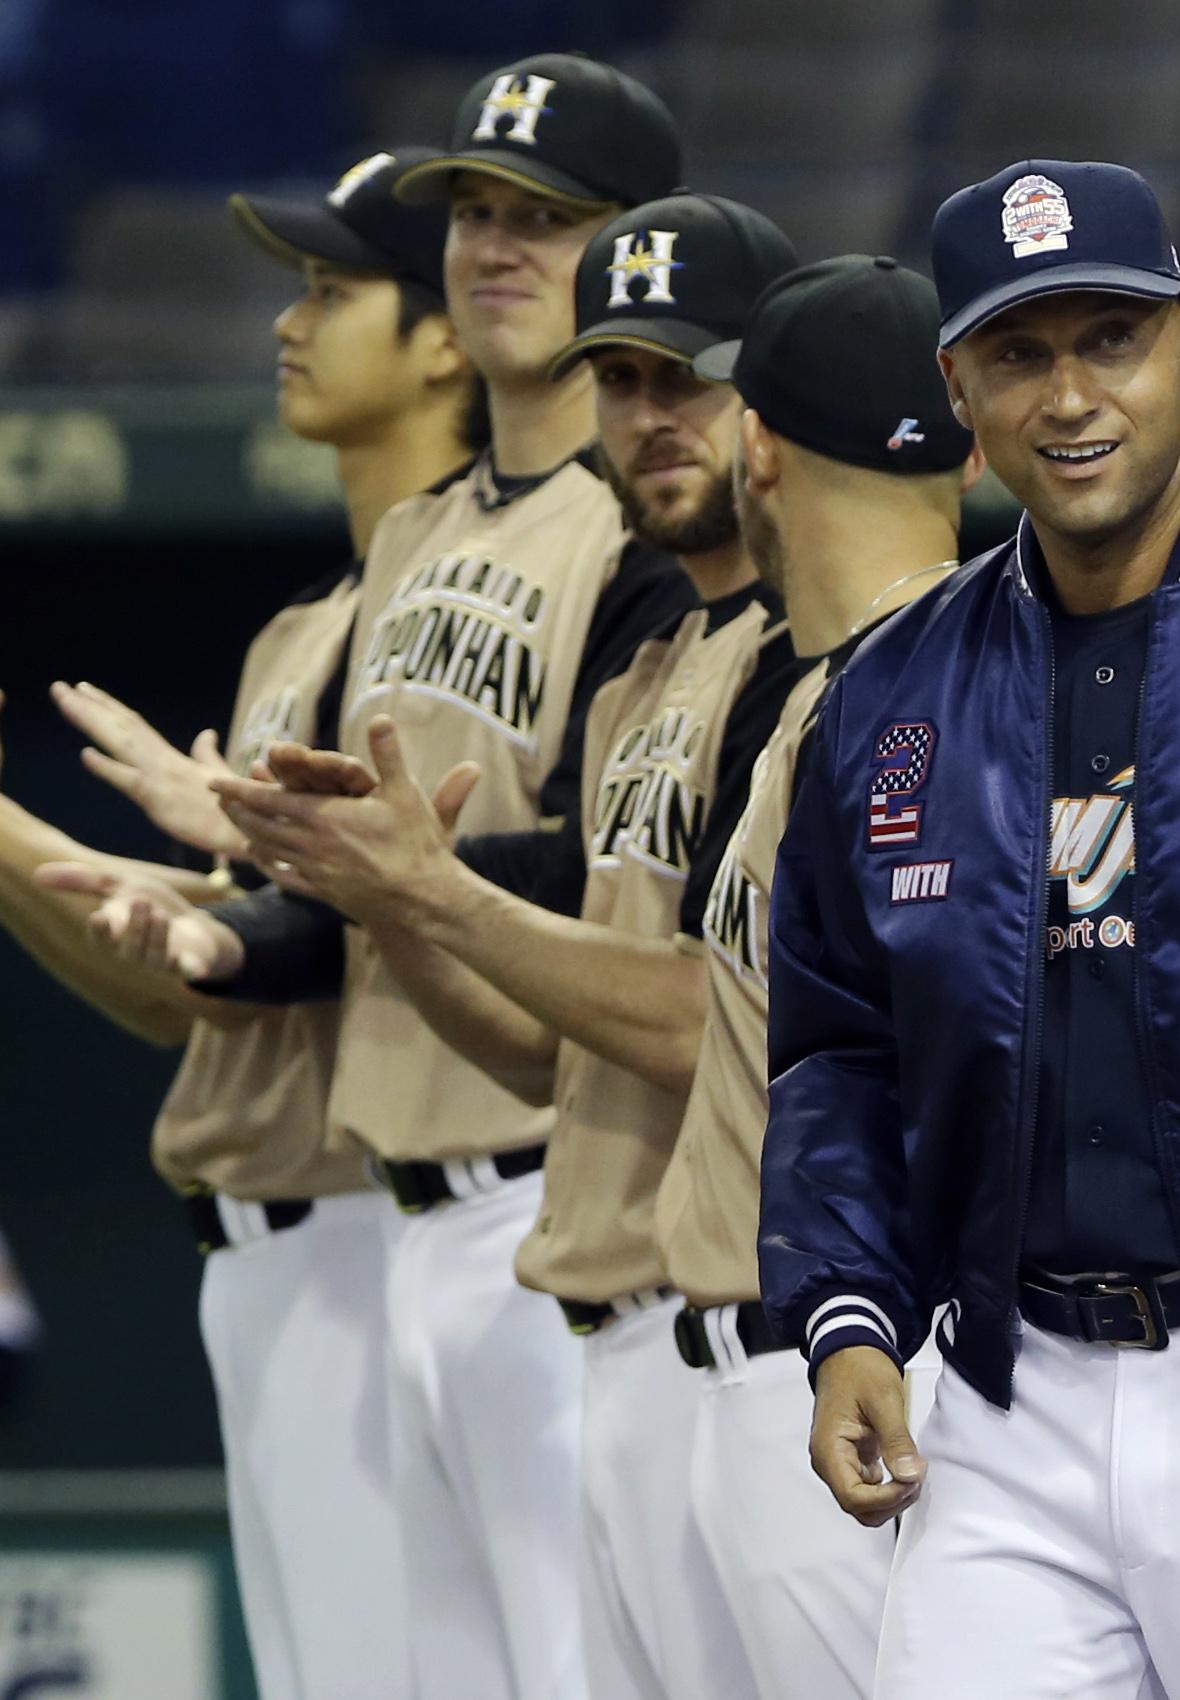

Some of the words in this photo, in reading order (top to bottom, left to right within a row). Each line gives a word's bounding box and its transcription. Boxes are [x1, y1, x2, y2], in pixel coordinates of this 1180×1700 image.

[472, 73, 557, 145] H
[1005, 208, 1017, 226] 2
[1016, 202, 1044, 218] WITH
[1042, 198, 1066, 215] 55
[606, 229, 681, 308] H
[870, 724, 934, 843] 2
[891, 863, 950, 901] WITH
